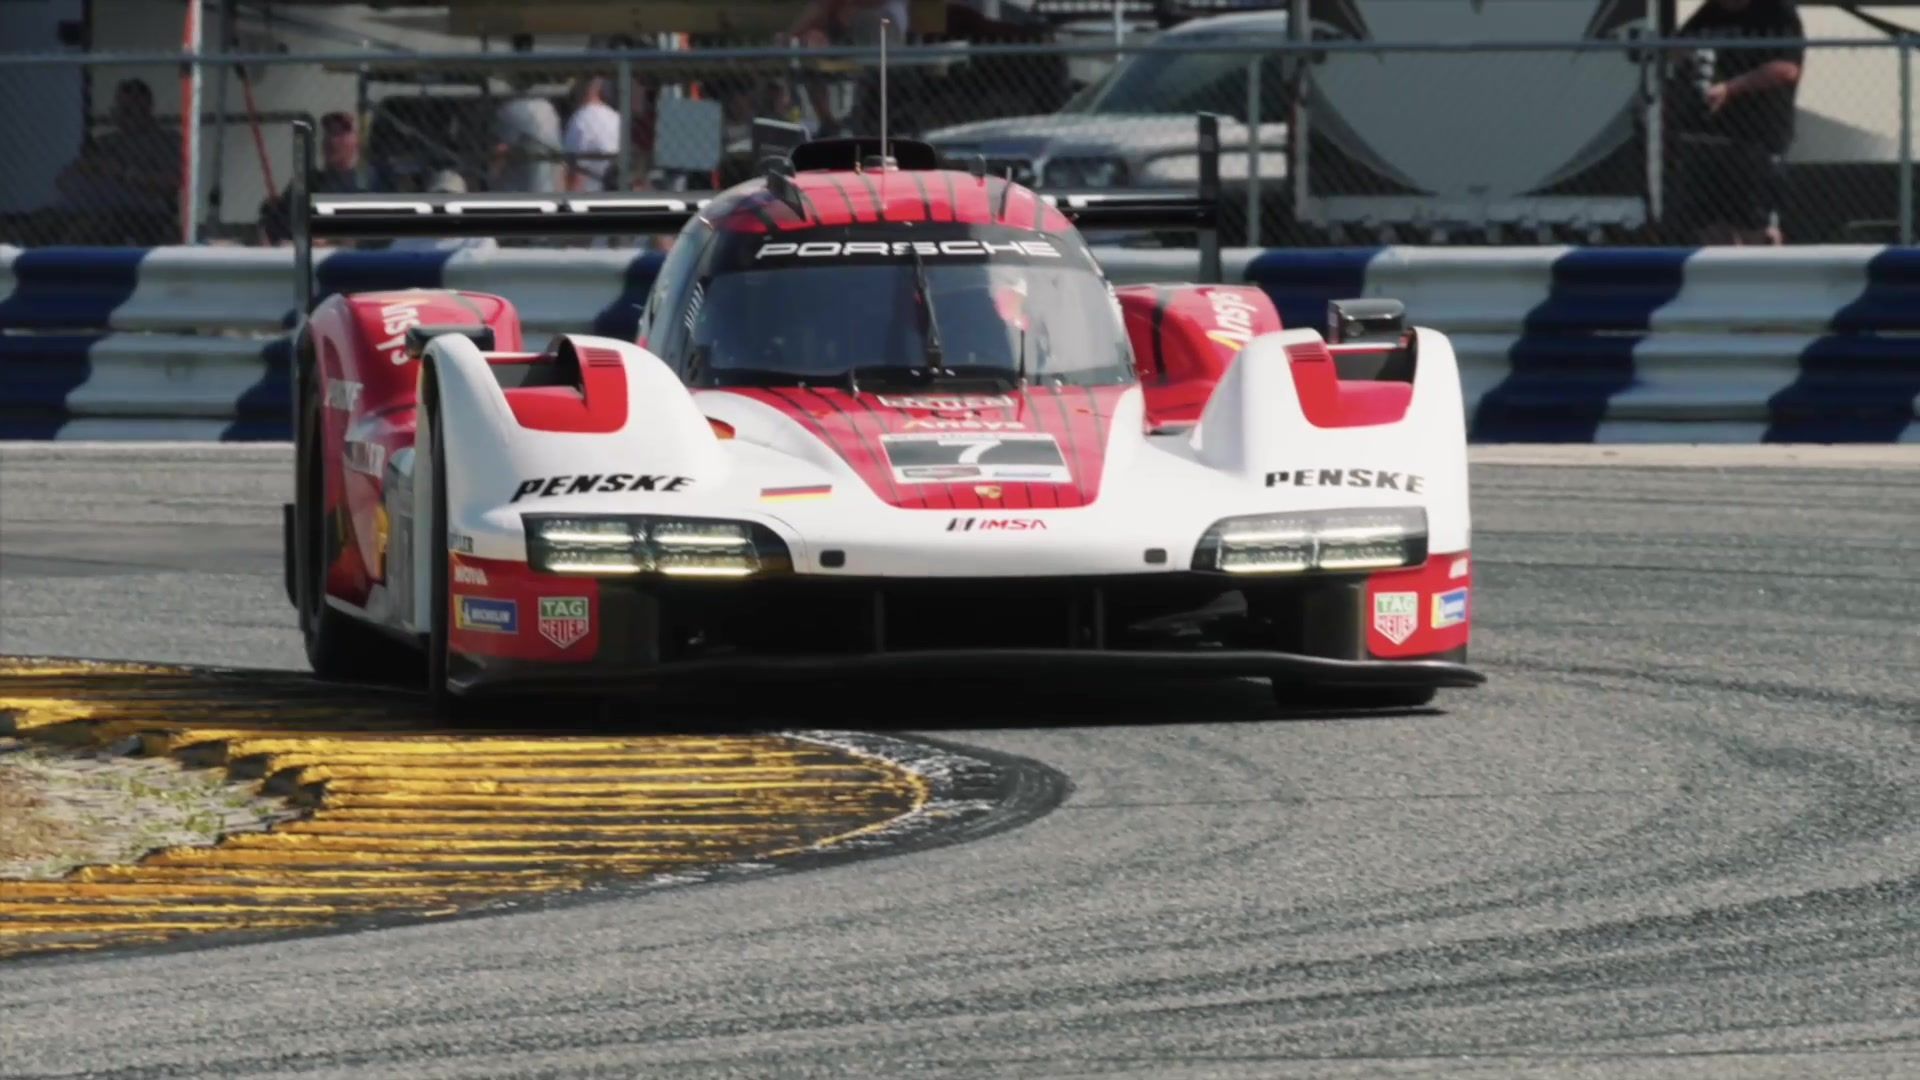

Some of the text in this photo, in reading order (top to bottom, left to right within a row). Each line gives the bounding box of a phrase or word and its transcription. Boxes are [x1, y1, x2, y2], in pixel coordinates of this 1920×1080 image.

[754, 240, 1062, 259] PORSCHE
[937, 438, 1002, 464] 7
[509, 473, 697, 503] PENSKE
[1265, 469, 1424, 495] PENSKE
[979, 519, 1047, 530] IMSA
[543, 601, 583, 616] TAG
[1377, 596, 1414, 613] TAG
[541, 619, 586, 644] HEUER
